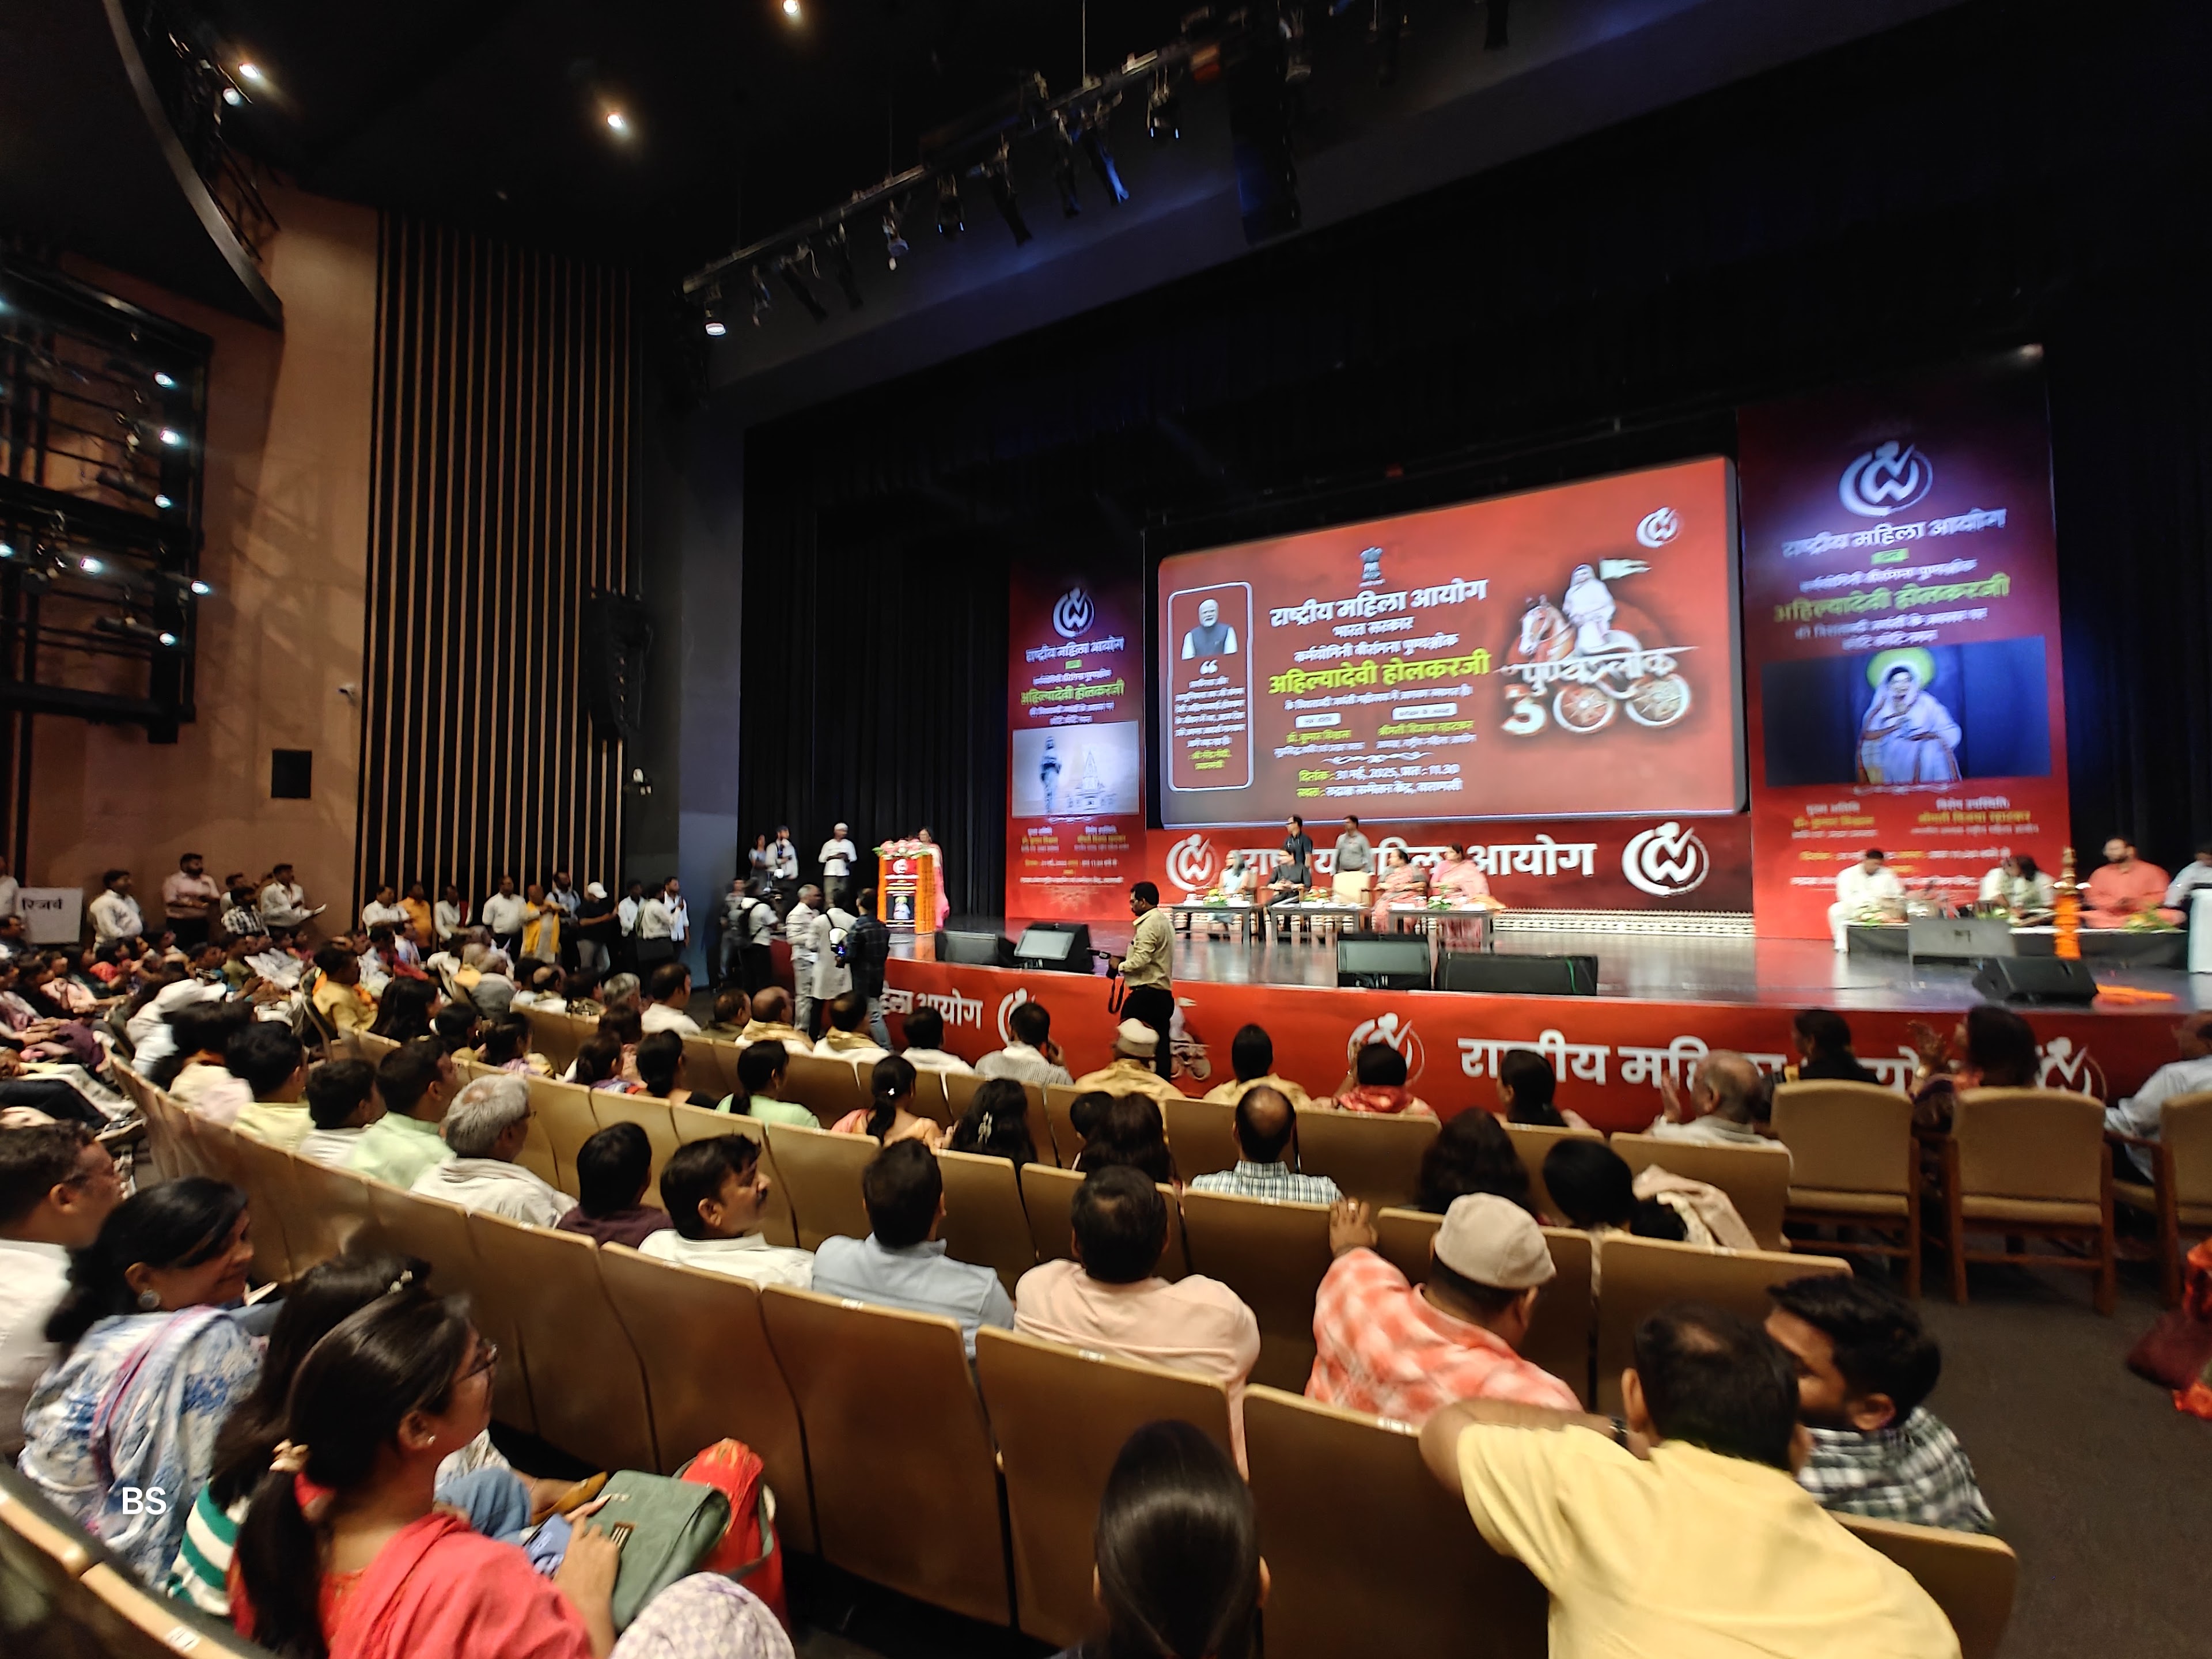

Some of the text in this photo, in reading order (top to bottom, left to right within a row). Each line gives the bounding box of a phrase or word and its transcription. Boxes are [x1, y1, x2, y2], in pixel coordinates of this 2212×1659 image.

[1851, 522, 1926, 547] महिला
[1927, 507, 2008, 537] आयोग
[1269, 577, 1489, 627] राष्ट्रीय महिला आयोग
[1268, 659, 1378, 695] अहिल्यादेवी
[1382, 647, 1492, 686] होलकरजी
[1467, 834, 1598, 877] आयोग
